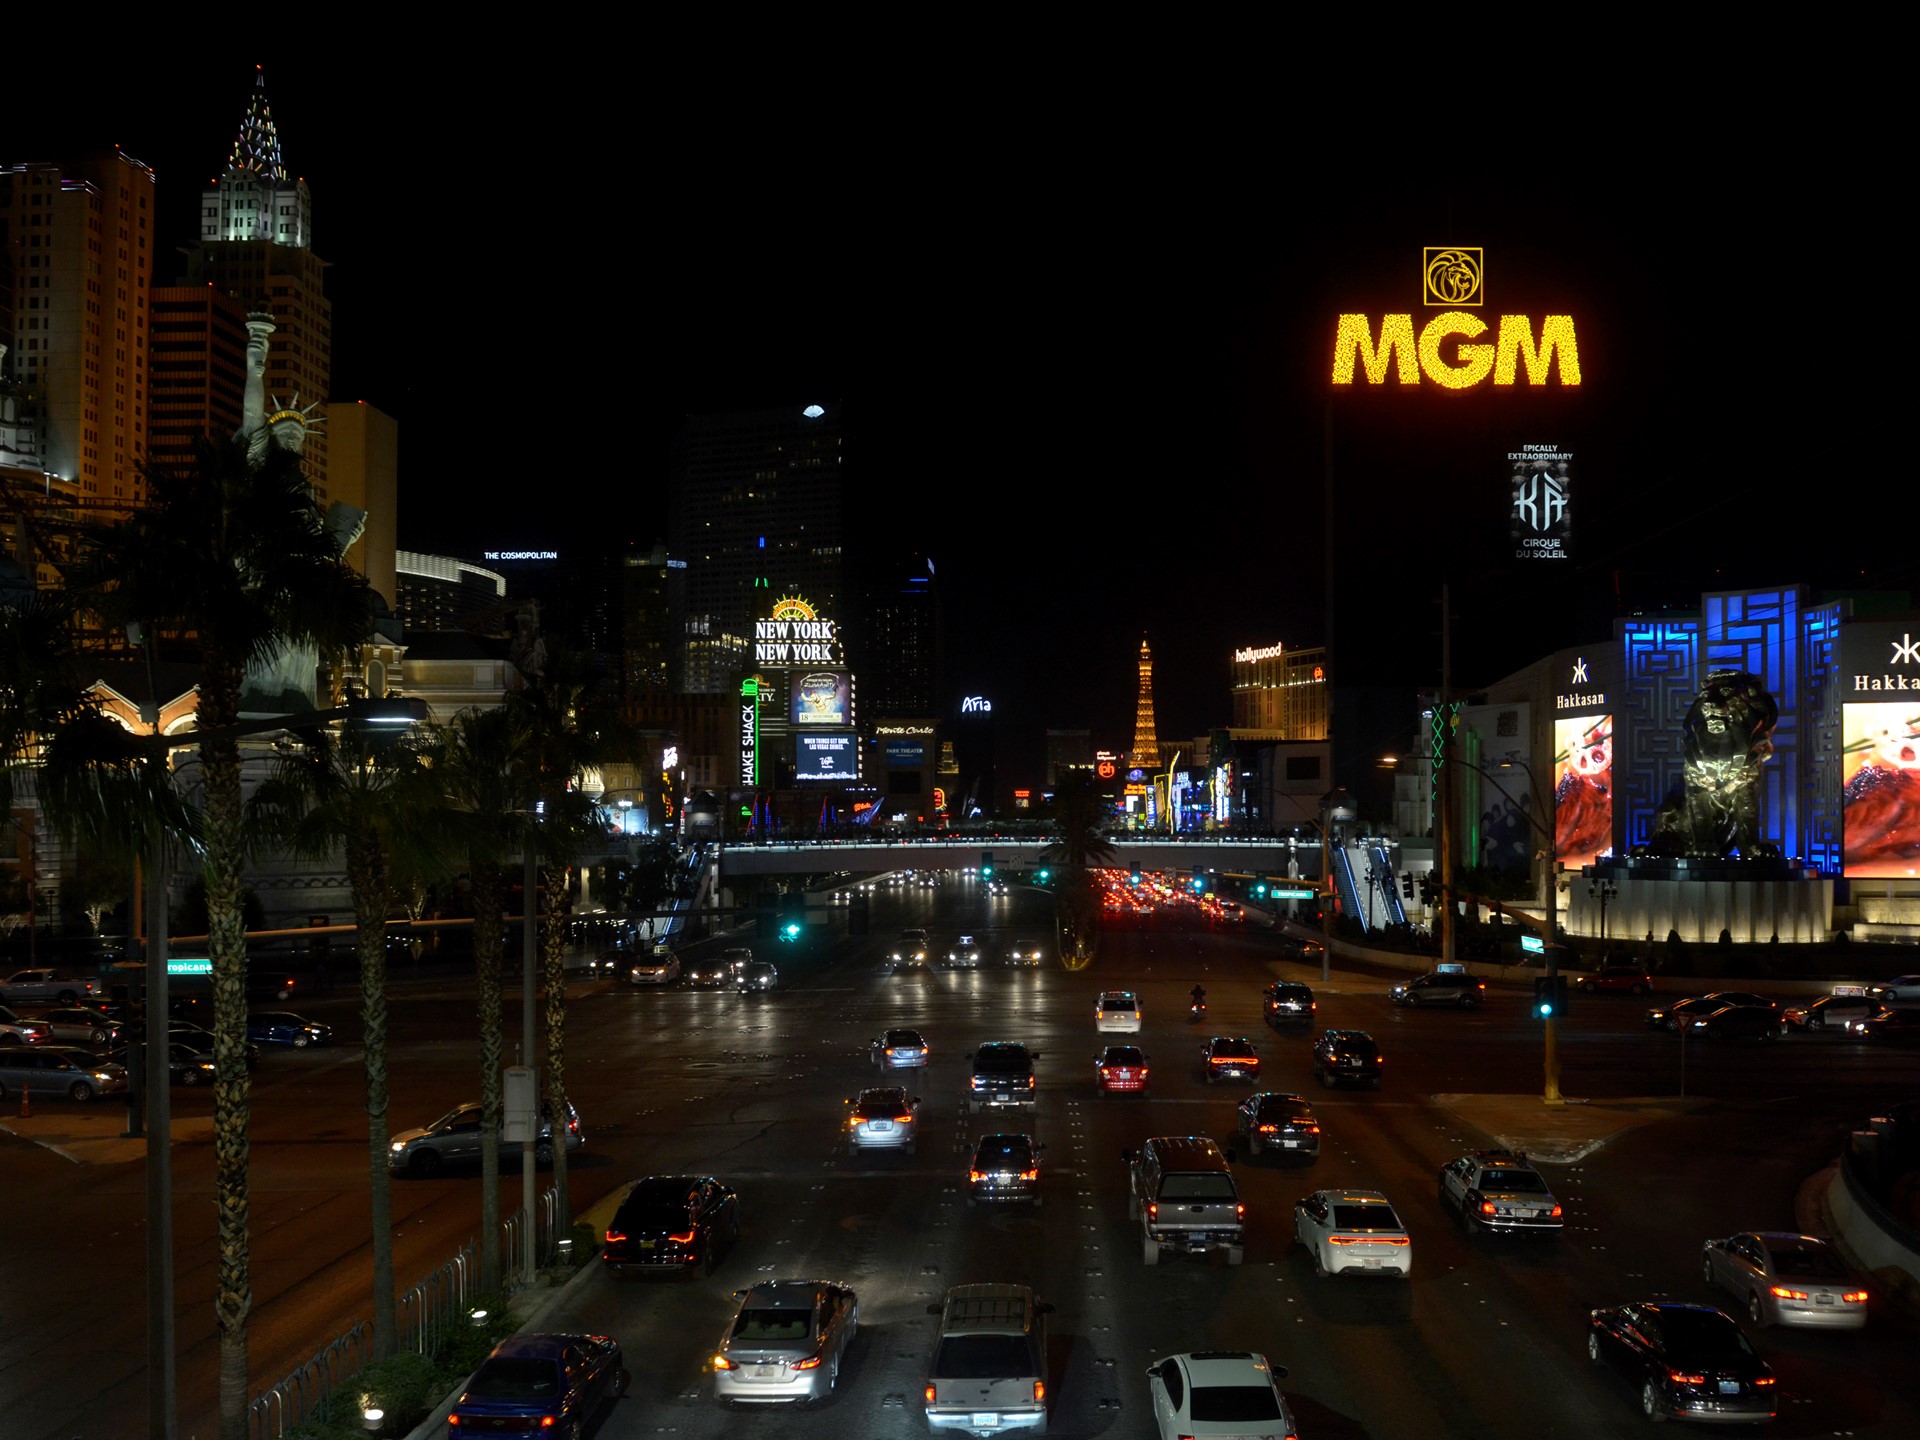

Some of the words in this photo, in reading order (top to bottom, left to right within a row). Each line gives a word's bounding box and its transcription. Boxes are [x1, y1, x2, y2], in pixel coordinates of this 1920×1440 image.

[1332, 311, 1582, 389] MGM
[1523, 539, 1561, 549] CIRQUE
[1516, 550, 1530, 558] DU
[1532, 550, 1567, 558] SOLEIL
[756, 622, 789, 639] NEW
[792, 622, 832, 639] YORK
[756, 644, 789, 660] NEW
[792, 644, 832, 660] YORK
[1236, 642, 1282, 664] hollywood
[1557, 693, 1605, 709] Hakkasan
[742, 705, 754, 746] SHACK
[876, 726, 905, 734] Monte
[906, 726, 934, 734] Carlo
[742, 750, 754, 785] HAKE
[168, 962, 213, 973] ropicana
